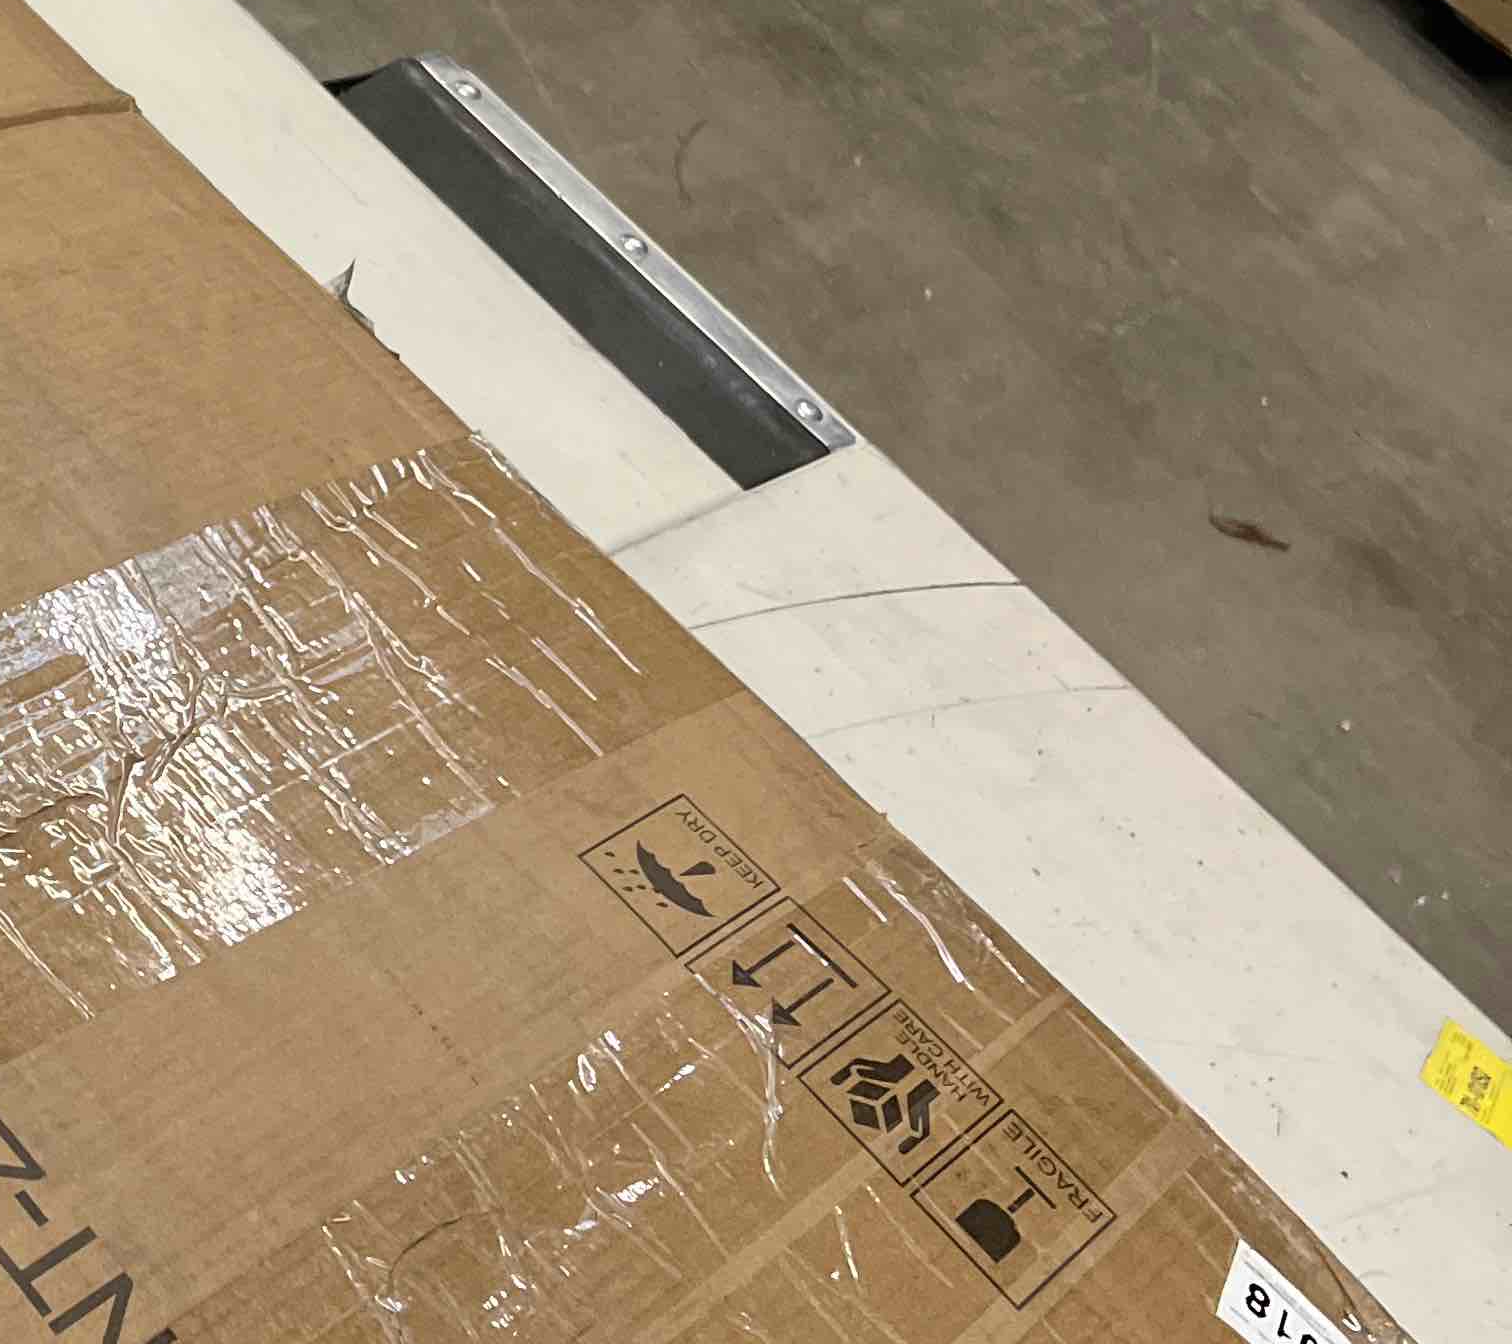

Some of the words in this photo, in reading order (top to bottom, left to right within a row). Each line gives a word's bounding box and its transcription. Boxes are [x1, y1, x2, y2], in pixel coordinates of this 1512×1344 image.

[676, 809, 718, 845] DRY
[713, 844, 763, 889] KEEP
[893, 1009, 946, 1058] CARE
[895, 1030, 968, 1102] HANDLE
[942, 1059, 991, 1106] WITH
[1001, 1120, 1103, 1224] FRAGILE
